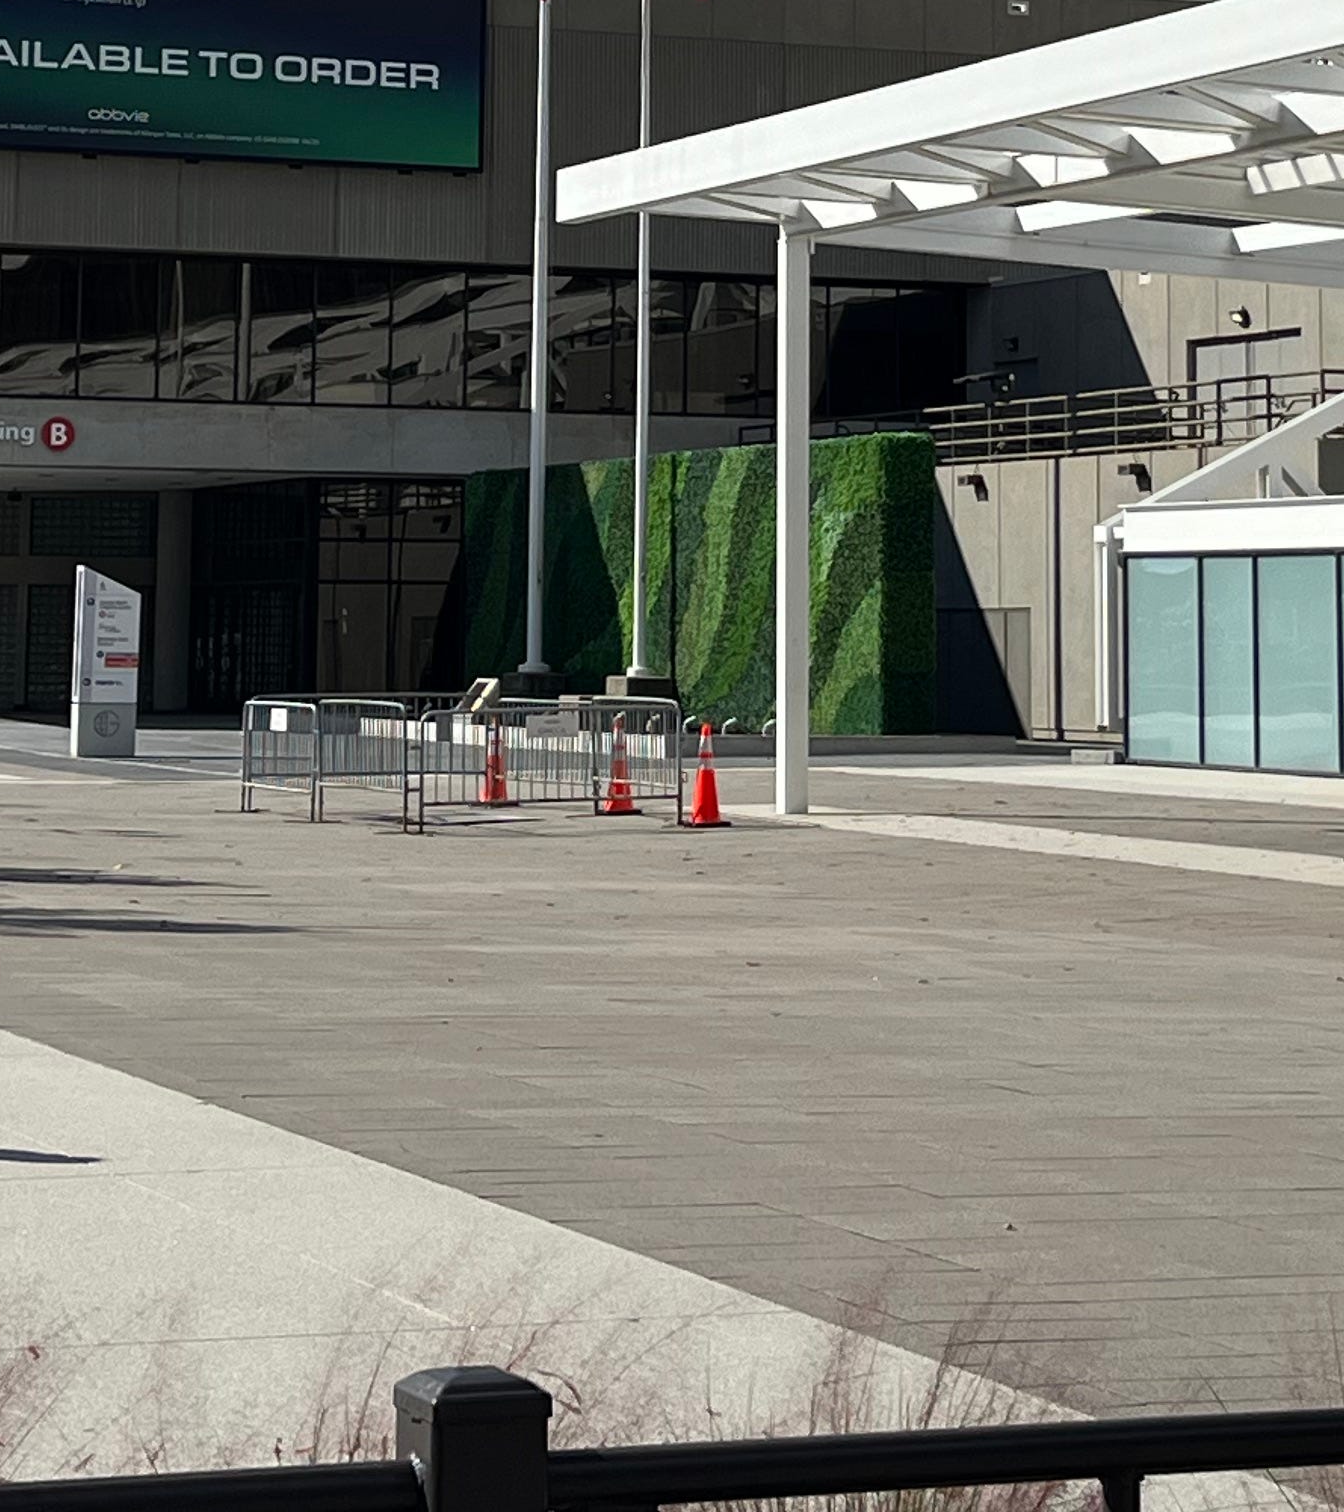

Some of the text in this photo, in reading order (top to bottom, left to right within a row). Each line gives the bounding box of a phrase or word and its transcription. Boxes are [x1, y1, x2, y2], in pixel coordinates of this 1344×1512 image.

[198, 50, 263, 81] TO
[274, 54, 441, 91] ORDER
[87, 108, 151, 124] abbvie
[49, 422, 68, 447] B
